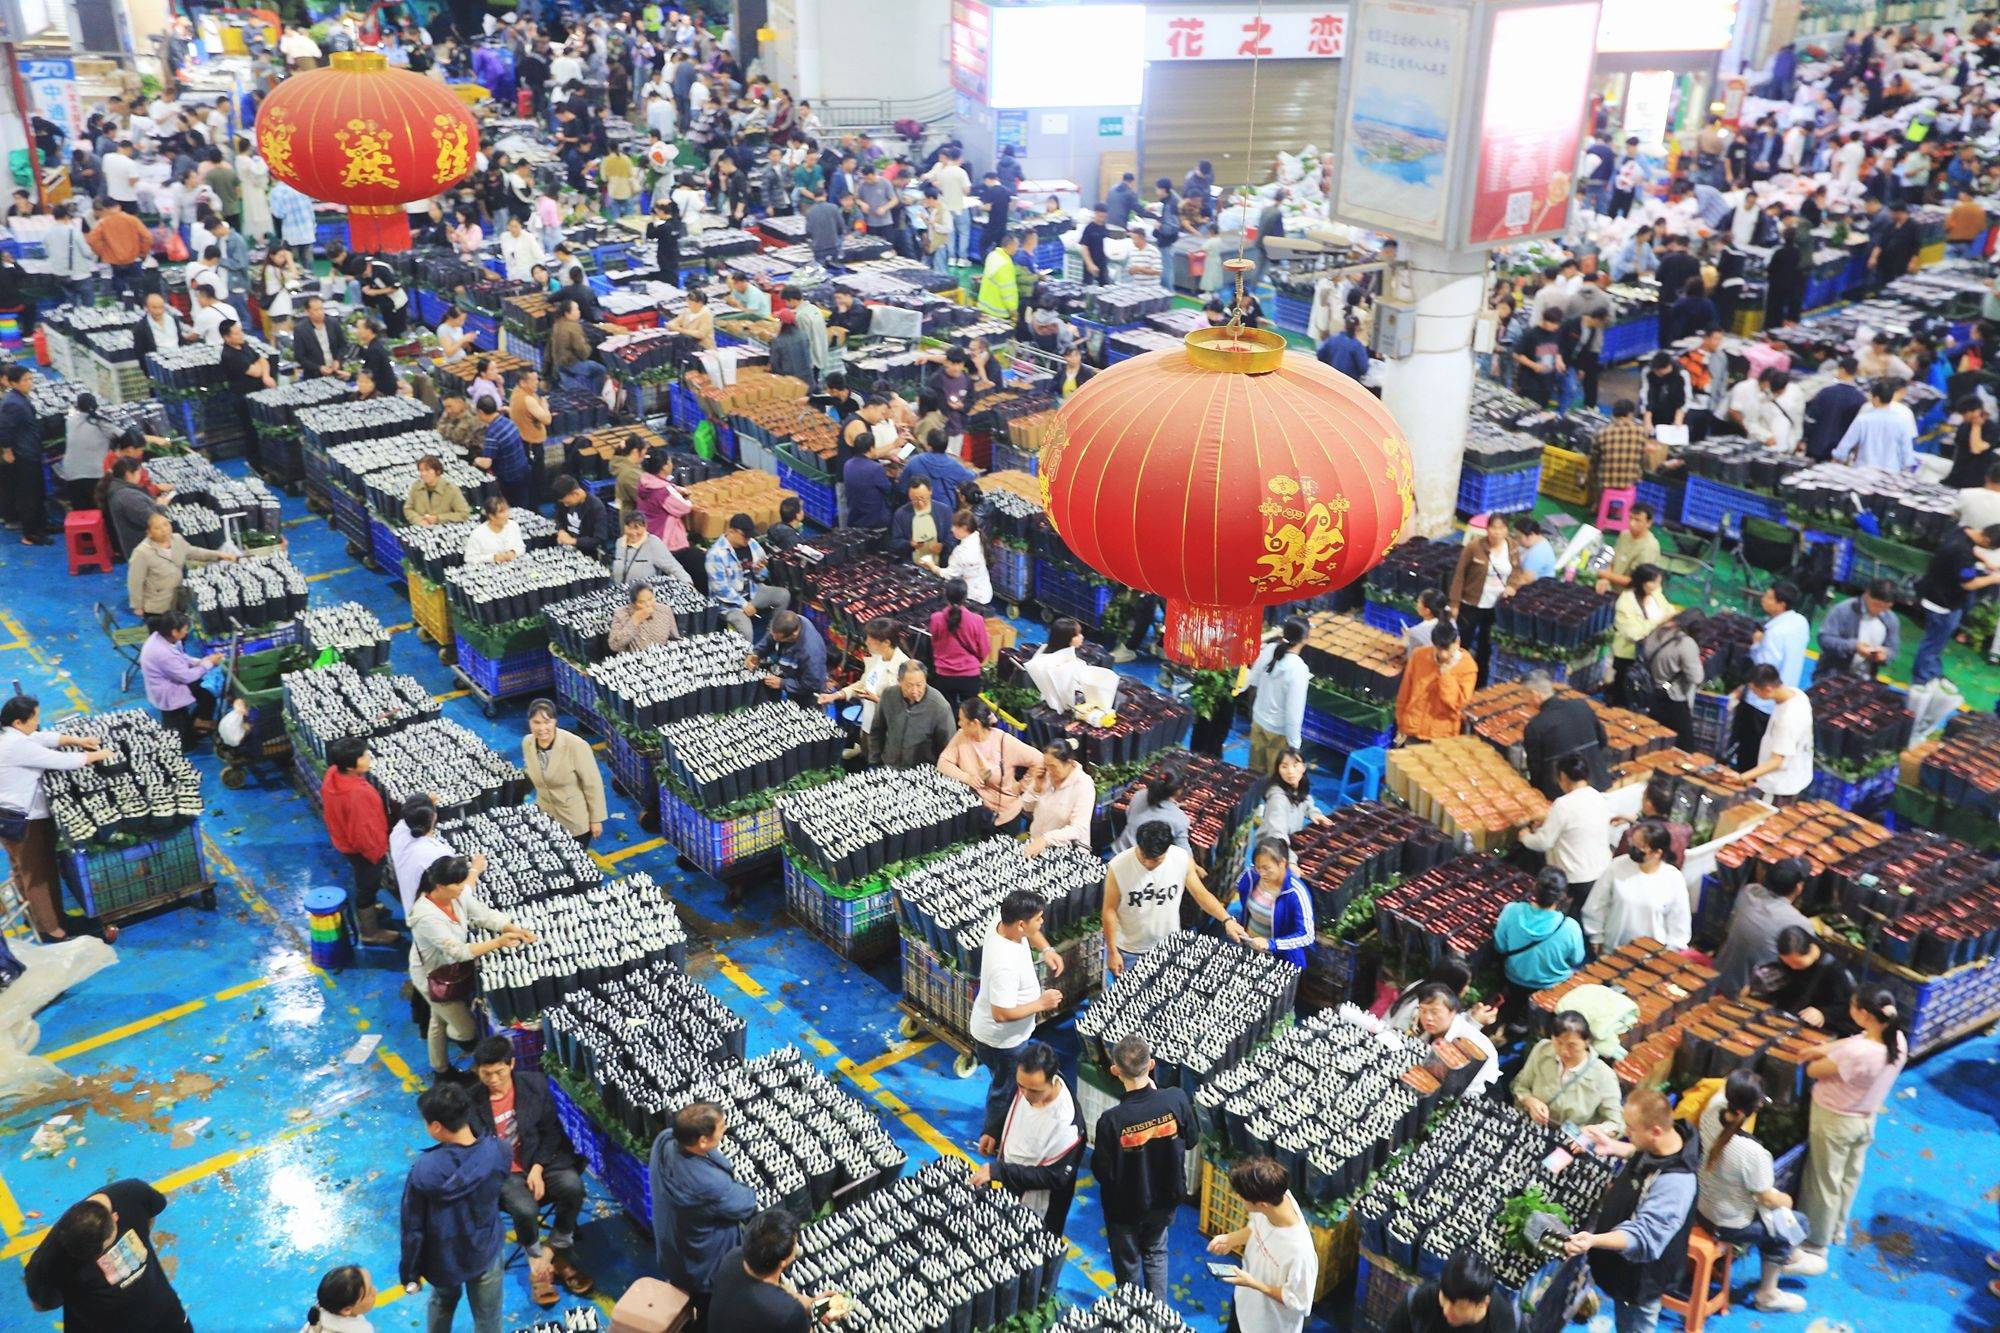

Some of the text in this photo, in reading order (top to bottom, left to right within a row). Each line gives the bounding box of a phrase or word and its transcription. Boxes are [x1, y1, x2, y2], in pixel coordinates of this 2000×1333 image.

[1167, 14, 1343, 57] 花之恋
[28, 61, 68, 78] ZTO
[1121, 1113, 1174, 1135] ARTISTIC LIFE
